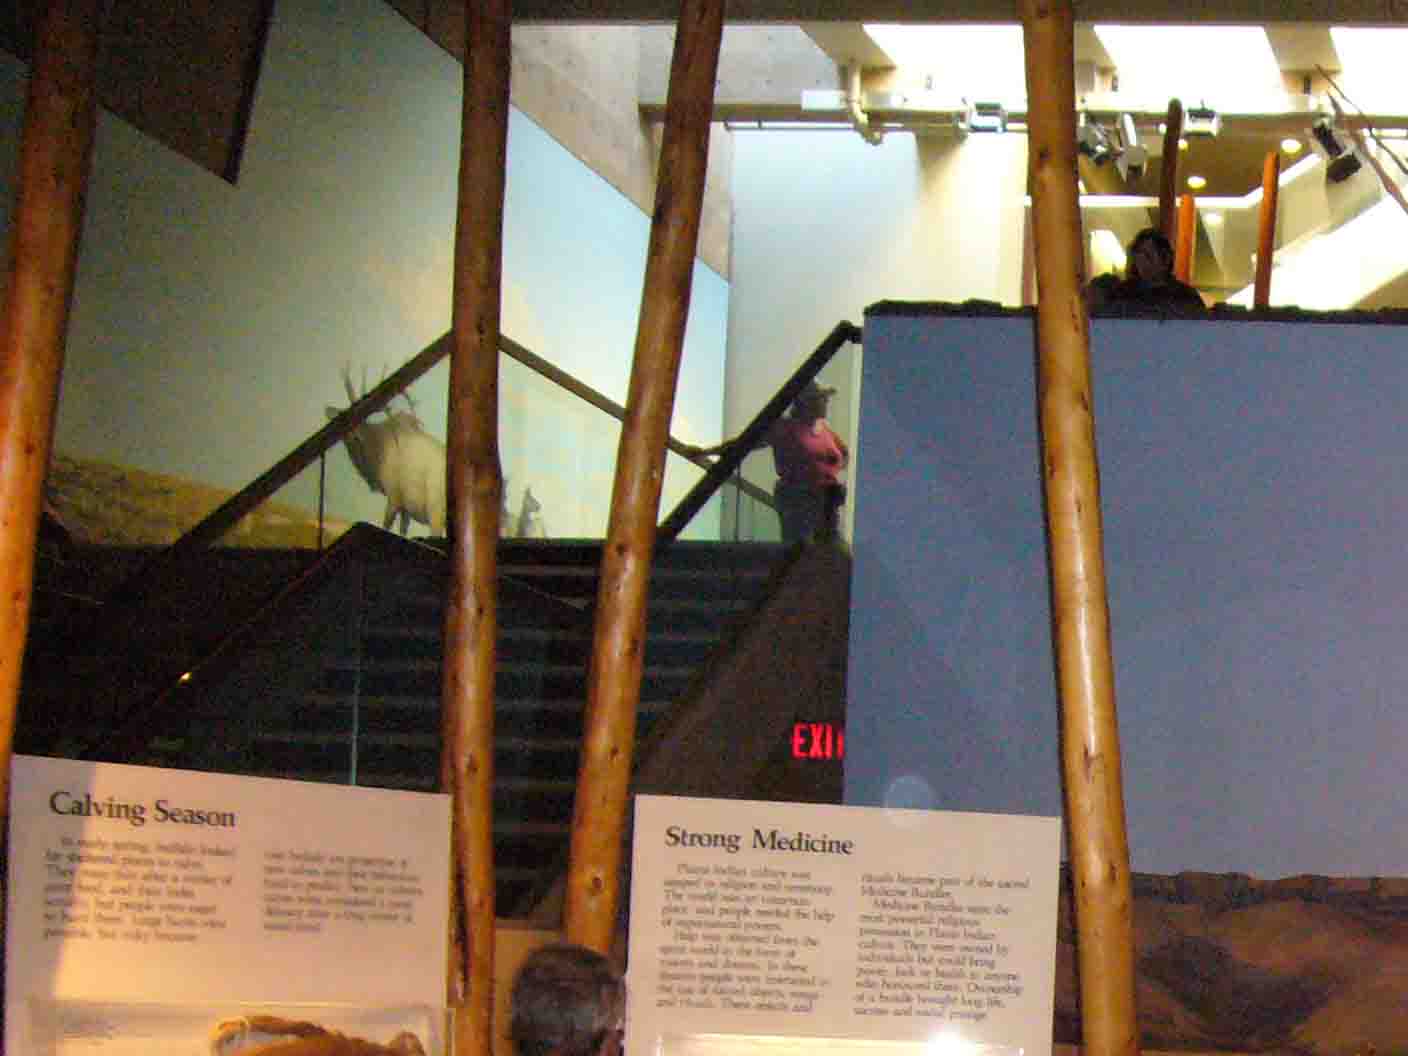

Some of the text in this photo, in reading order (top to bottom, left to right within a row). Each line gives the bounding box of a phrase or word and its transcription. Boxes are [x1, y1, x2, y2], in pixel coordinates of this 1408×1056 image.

[49, 791, 236, 827] Calving Season
[665, 825, 854, 854] Strong Medicine
